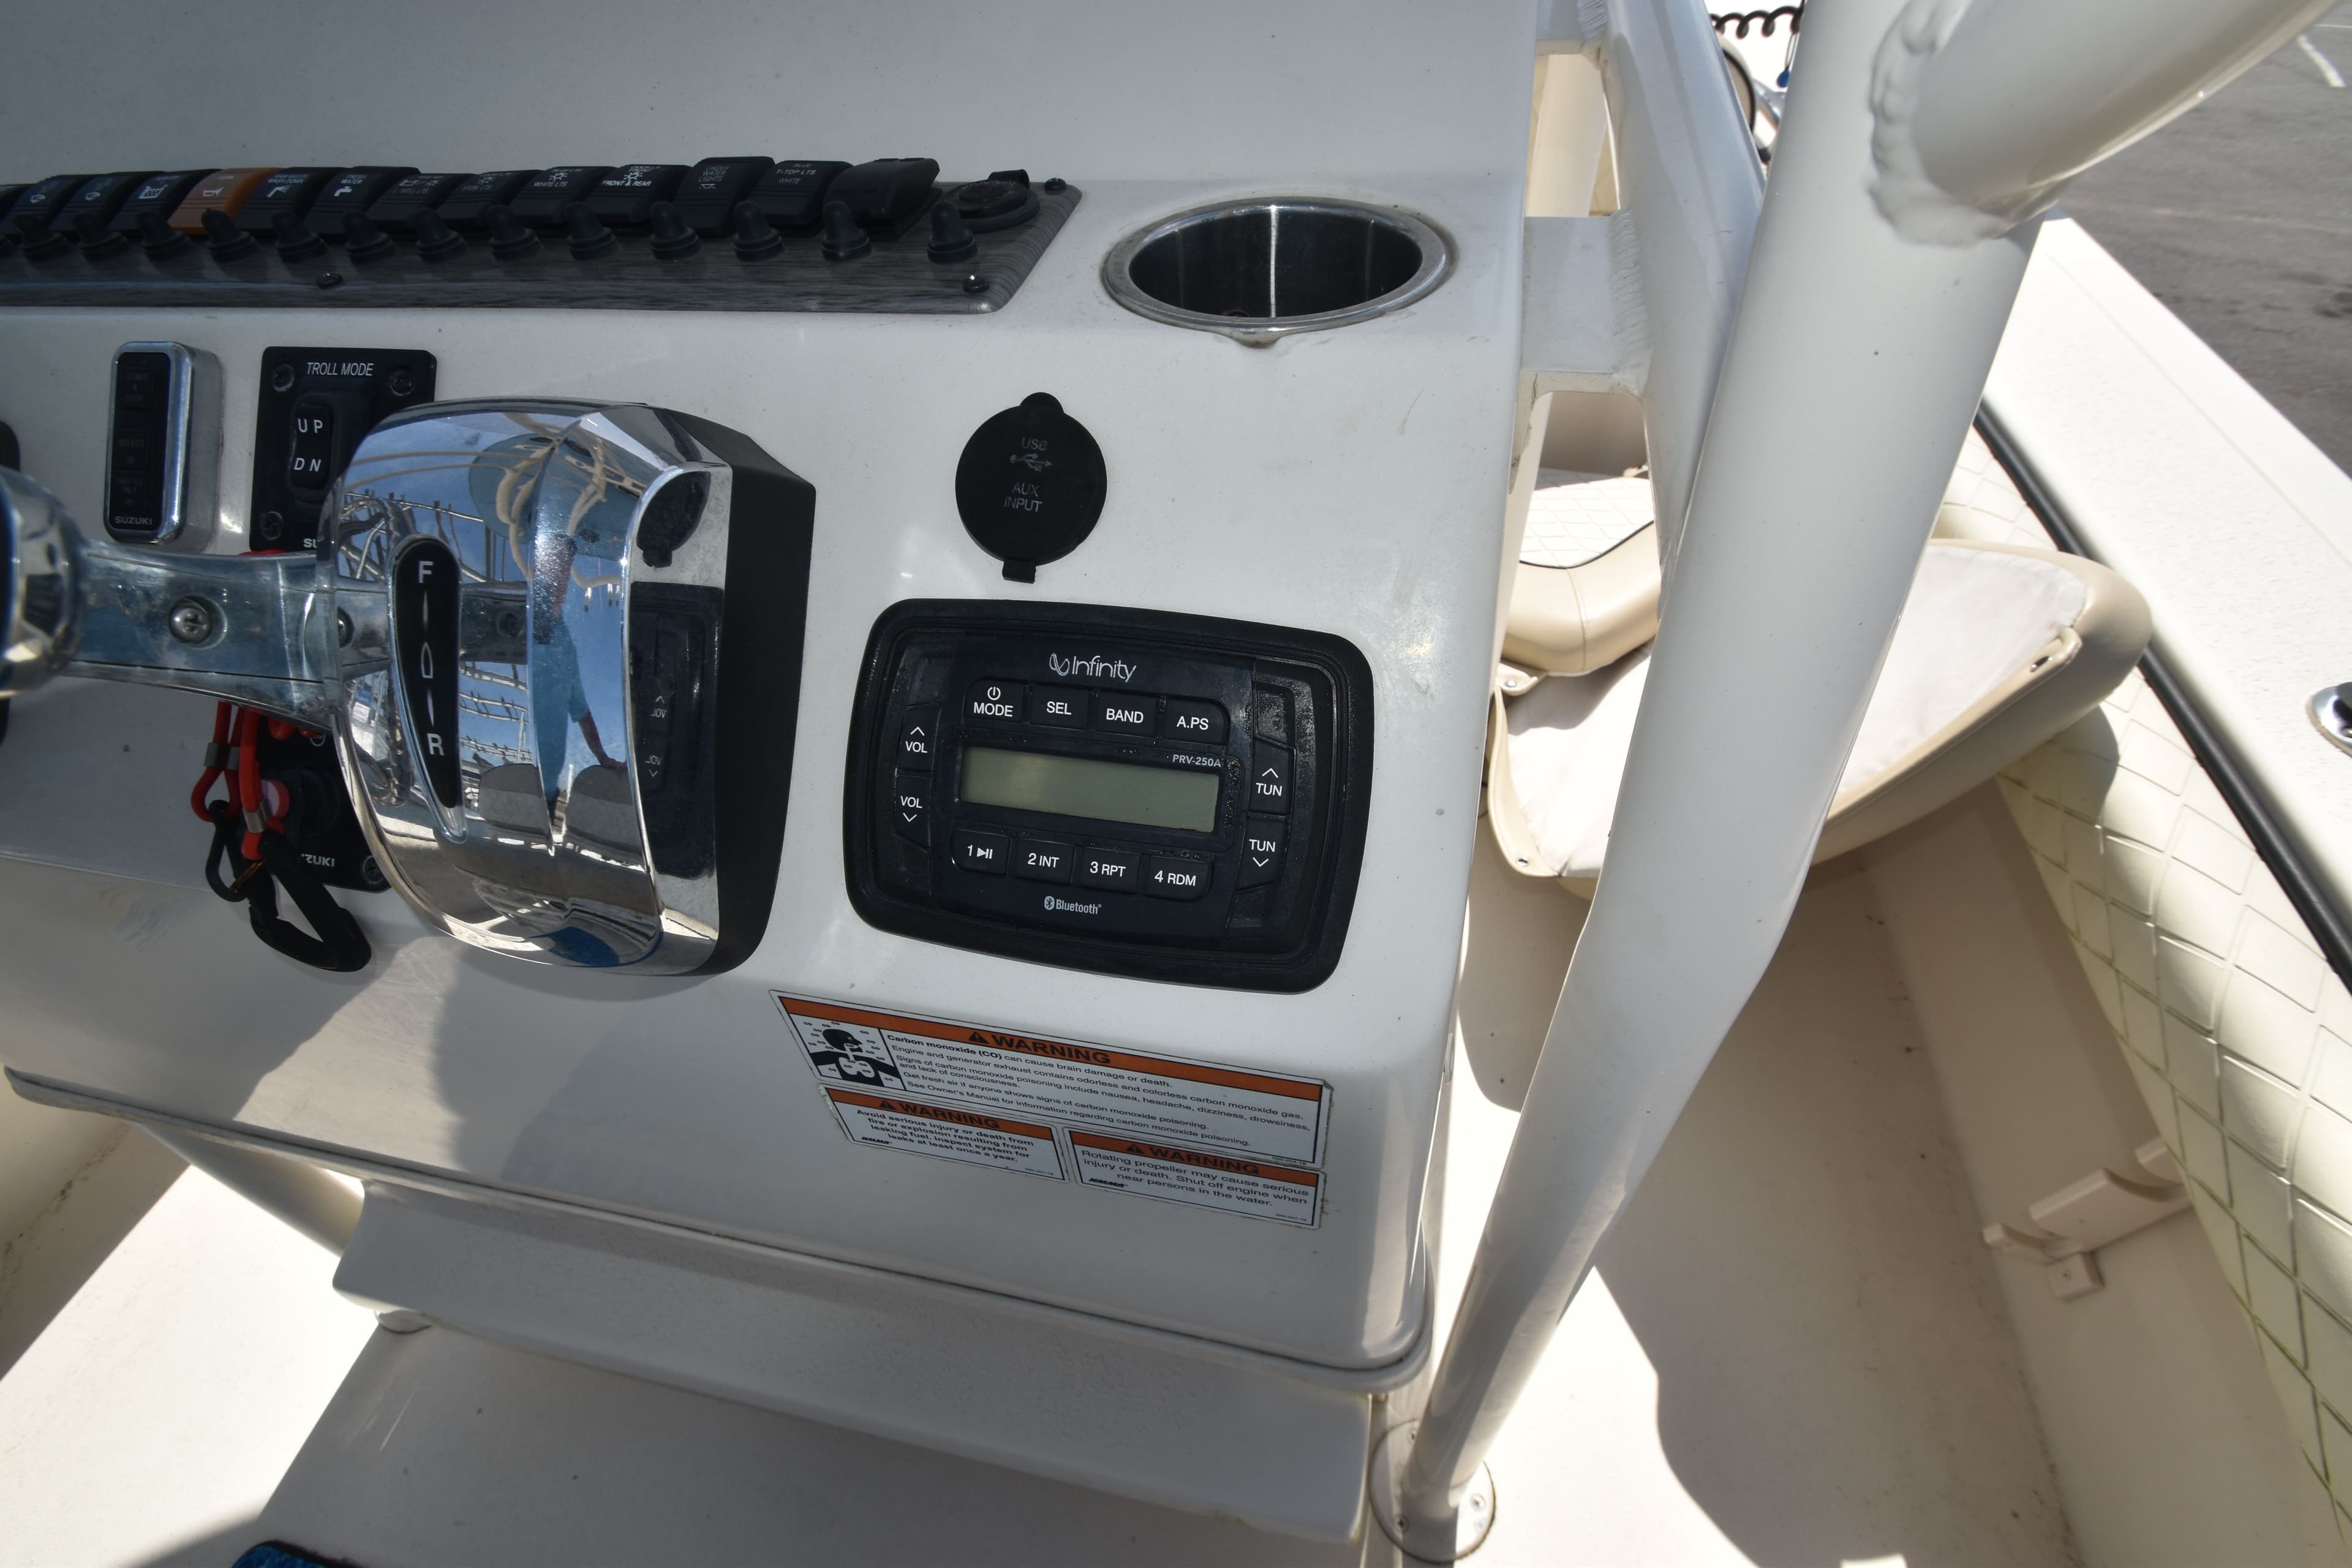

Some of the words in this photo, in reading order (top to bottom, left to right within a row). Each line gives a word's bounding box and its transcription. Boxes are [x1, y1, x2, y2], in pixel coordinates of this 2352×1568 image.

[307, 363, 339, 375] TROLL
[341, 363, 374, 376] MODE
[298, 419, 322, 433] UP
[1022, 437, 1047, 451] USB
[1012, 482, 1039, 497] AUX
[1004, 496, 1042, 512] INPUT
[115, 516, 153, 525] SUZUKI
[419, 561, 433, 583] F
[1072, 656, 1136, 682] Infinity
[973, 703, 1014, 717] MODE
[1047, 701, 1071, 715] SEL
[1107, 709, 1143, 723] BAND
[1177, 716, 1208, 729] A.PS
[428, 733, 443, 755] R
[906, 741, 927, 753] VOL
[1173, 755, 1221, 767] PRV-250A
[1256, 783, 1282, 796] TUN
[901, 796, 922, 808] VOL
[968, 845, 973, 856] 1
[1250, 839, 1275, 852] TUN
[301, 854, 334, 867] ZUKI
[1028, 853, 1036, 865] 2
[1039, 856, 1059, 867] INT
[1090, 862, 1098, 873] 3
[1102, 864, 1126, 876] RPT
[1155, 870, 1163, 882] 4
[1168, 873, 1196, 886] RDM
[991, 1034, 1110, 1064] WARNING
[887, 1035, 924, 1046] Carbon
[925, 1042, 976, 1055] monoxide
[978, 1050, 1002, 1060] (CO)
[1024, 1059, 1054, 1068] cause
[1056, 1063, 1082, 1072] brain
[1084, 1068, 1125, 1079] damage
[1140, 1077, 1172, 1087] death.
[895, 1055, 922, 1064] Signs
[935, 1063, 967, 1072] carbon
[968, 1068, 1014, 1080] monoxide
[1016, 1077, 1062, 1089] poisoning
[1064, 1084, 1099, 1095] include
[918, 1065, 937, 1074] lack
[891, 1044, 924, 1055] Engine
[946, 1055, 991, 1066] generator
[993, 1063, 1031, 1074] exhaust
[1033, 1070, 1074, 1081] contains
[1076, 1077, 1118, 1088] odorless
[1142, 1088, 1188, 1099] colorless
[1189, 1096, 1225, 1106] carbon
[1228, 1102, 1278, 1115] monoxide
[921, 1074, 944, 1084] fresh
[968, 1084, 1002, 1093] anyone
[1004, 1090, 1034, 1099] shows
[1074, 1102, 1107, 1112] carbon
[1110, 1108, 1156, 1120] monoxide
[899, 1103, 1000, 1129] WARNING
[907, 1080, 925, 1089] See
[927, 1084, 965, 1096] Owner's
[965, 1091, 1000, 1102] Manual
[1016, 1100, 1068, 1114] information
[1069, 1110, 1114, 1123] regarding
[1116, 1118, 1149, 1128] carbon
[1152, 1125, 1198, 1137] monoxide
[857, 1109, 886, 1119] Avoid
[888, 1116, 927, 1126] serious
[929, 1122, 959, 1133] injury
[976, 1131, 1006, 1141] death
[1008, 1137, 1034, 1146] from
[870, 1124, 908, 1136] leaking
[933, 1136, 972, 1147] Inspect
[974, 1144, 1012, 1155] system
[888, 1133, 914, 1142] leaks
[929, 1140, 954, 1150] least
[900, 1125, 951, 1137] explosion
[953, 1134, 1000, 1147] resulting
[1001, 1142, 1027, 1151] from
[1149, 1147, 1259, 1174] WARNING
[1081, 1150, 1131, 1165] Rotating
[1134, 1161, 1188, 1174] propeller
[1191, 1170, 1218, 1180] may
[1221, 1176, 1259, 1187] cause
[1262, 1183, 1308, 1196] serious
[1084, 1158, 1115, 1170] injury
[1176, 1175, 1204, 1186] Shut
[1226, 1186, 1269, 1197] engine
[1272, 1193, 1306, 1204] when
[1117, 1174, 1144, 1182] near
[1147, 1179, 1196, 1192] persons
[1213, 1190, 1232, 1199] the
